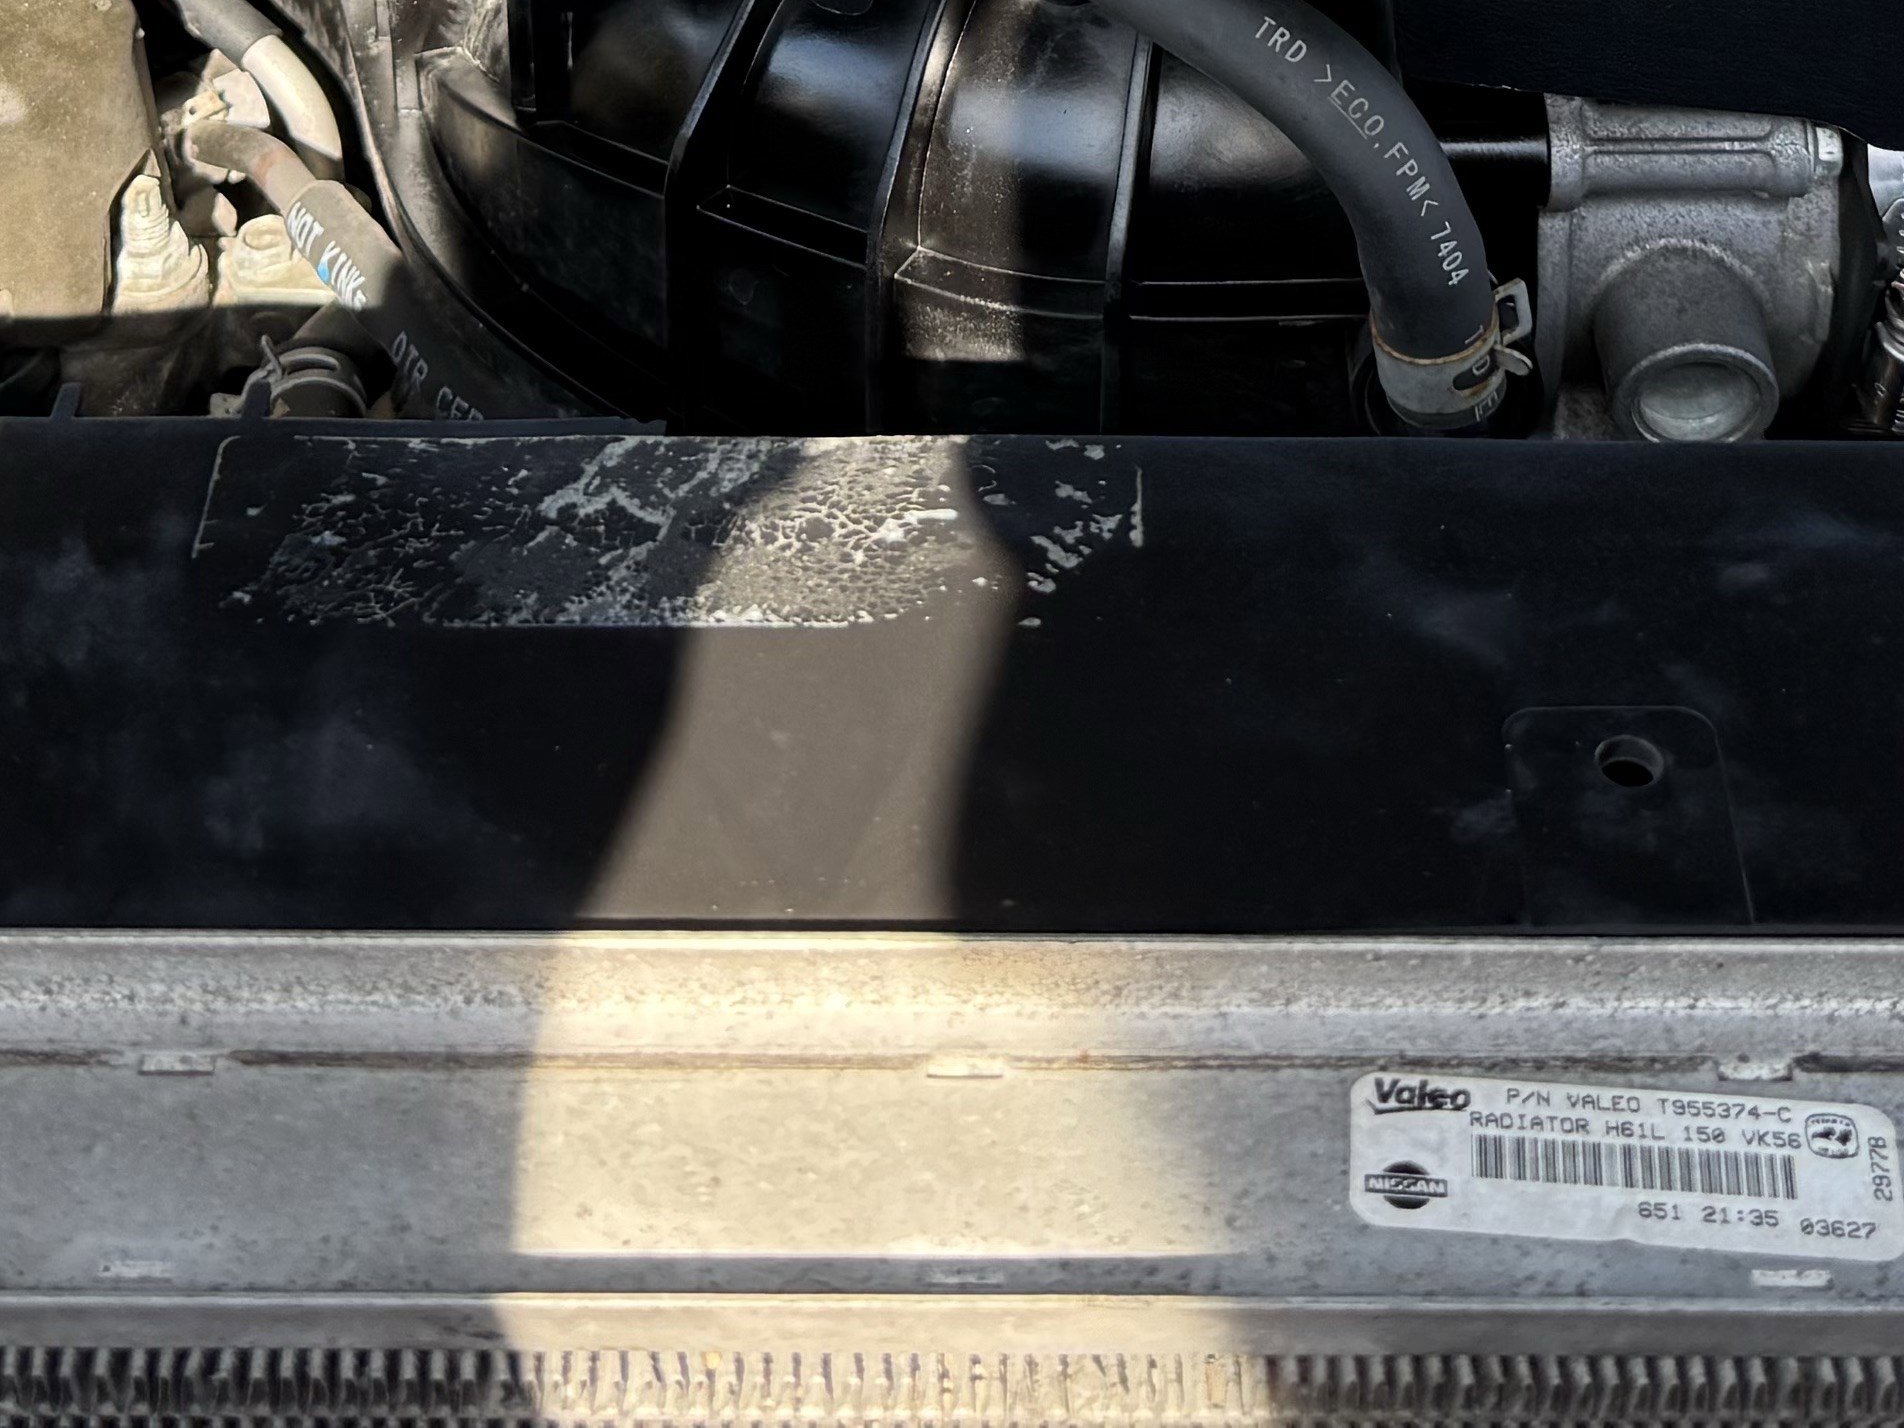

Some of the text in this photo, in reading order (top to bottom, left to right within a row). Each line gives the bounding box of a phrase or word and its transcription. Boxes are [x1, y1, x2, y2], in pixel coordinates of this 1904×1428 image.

[1254, 16, 1307, 64] TRD
[1431, 221, 1470, 286] 7404
[287, 201, 324, 258] NOT
[1372, 1076, 1471, 1112] Valeo
[1506, 1087, 1792, 1123] P/N VALEO T955374-C
[1470, 1110, 1590, 1135] RADIATOR
[1605, 1119, 1666, 1140] H61L
[1683, 1126, 1726, 1144] 150
[1742, 1128, 1801, 1149] VK56
[1368, 1176, 1445, 1194] NISSAN
[1638, 1201, 1877, 1240] 651 21:35 03627
